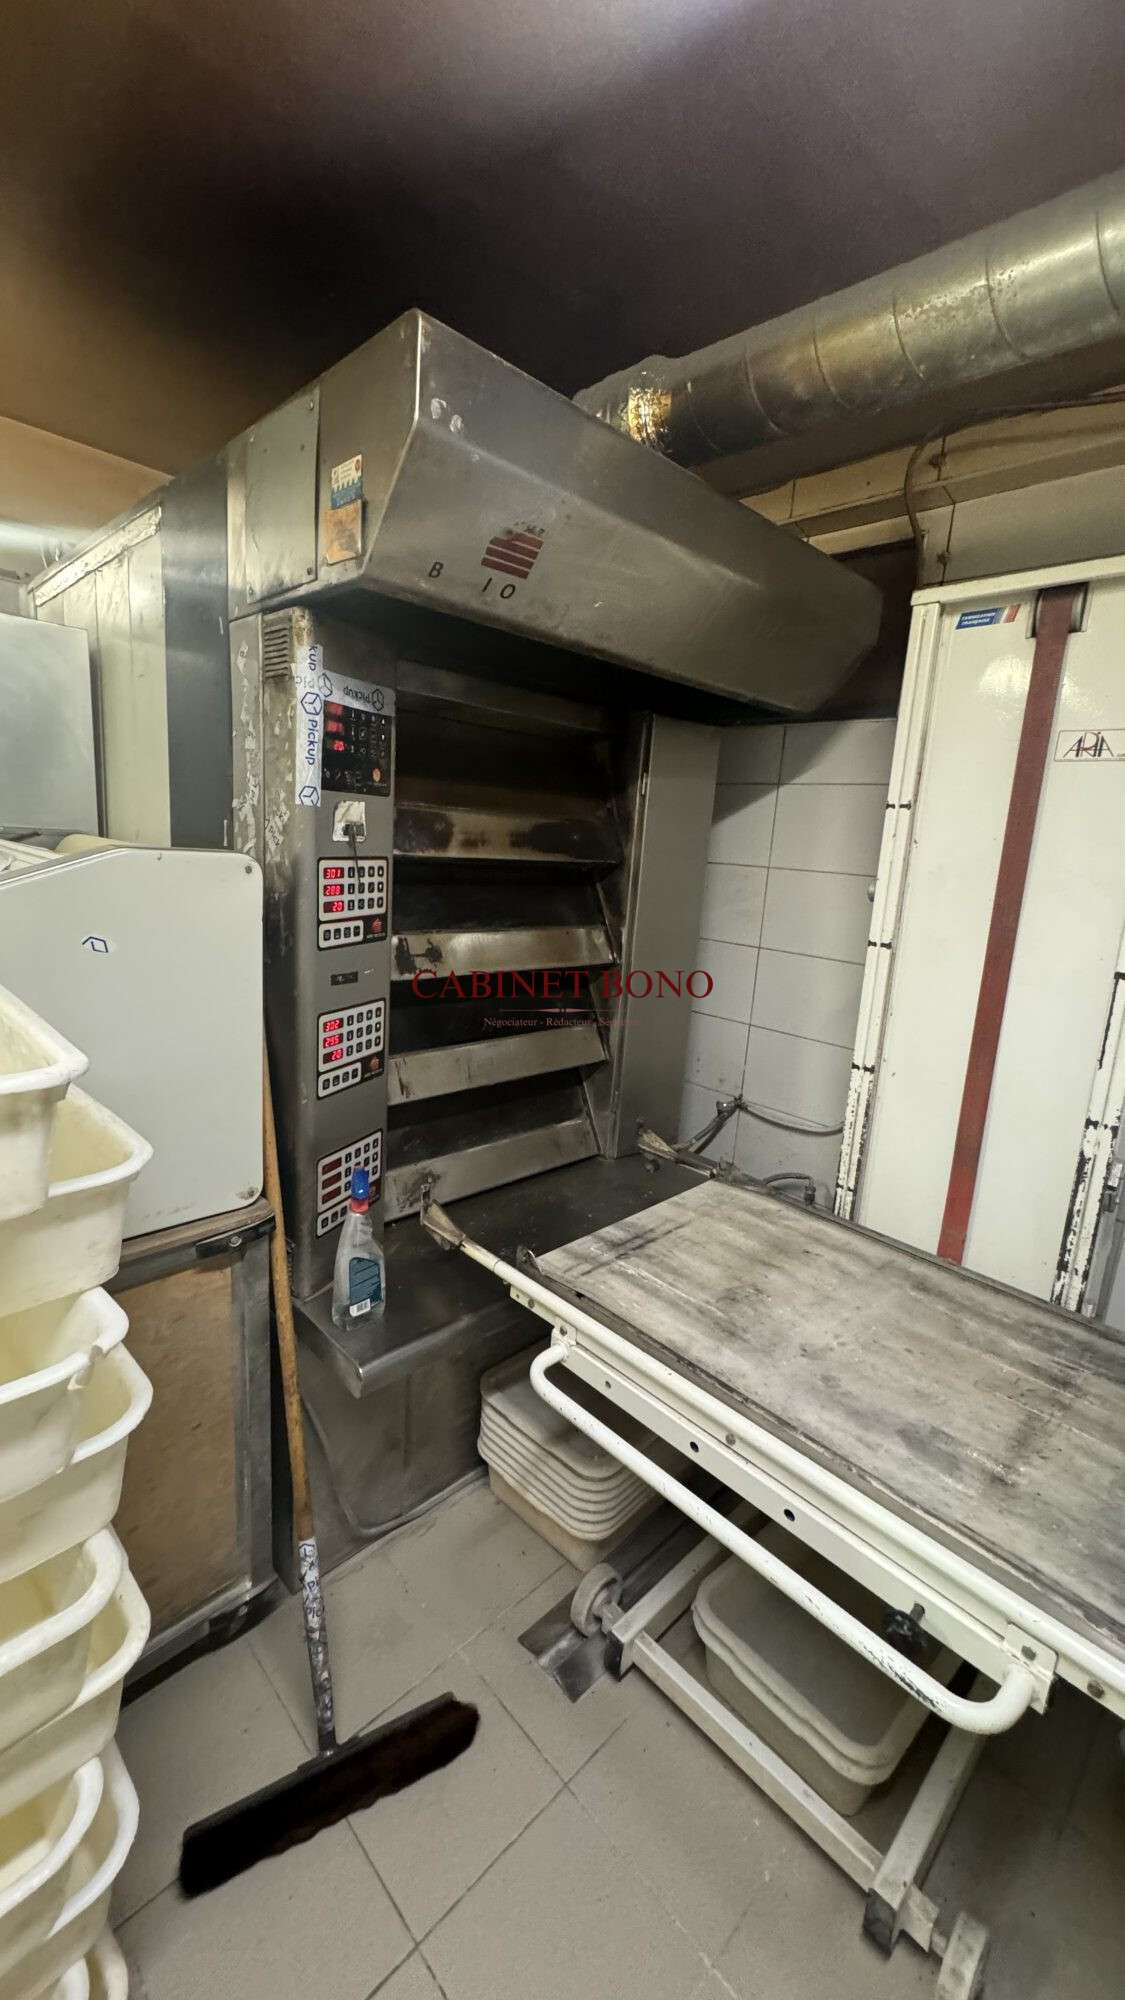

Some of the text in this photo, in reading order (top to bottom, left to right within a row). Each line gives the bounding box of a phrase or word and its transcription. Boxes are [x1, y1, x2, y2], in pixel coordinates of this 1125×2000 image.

[428, 561, 444, 579] B
[304, 718, 318, 766] Pickup
[325, 868, 341, 879] 301
[326, 1019, 340, 1032] 302
